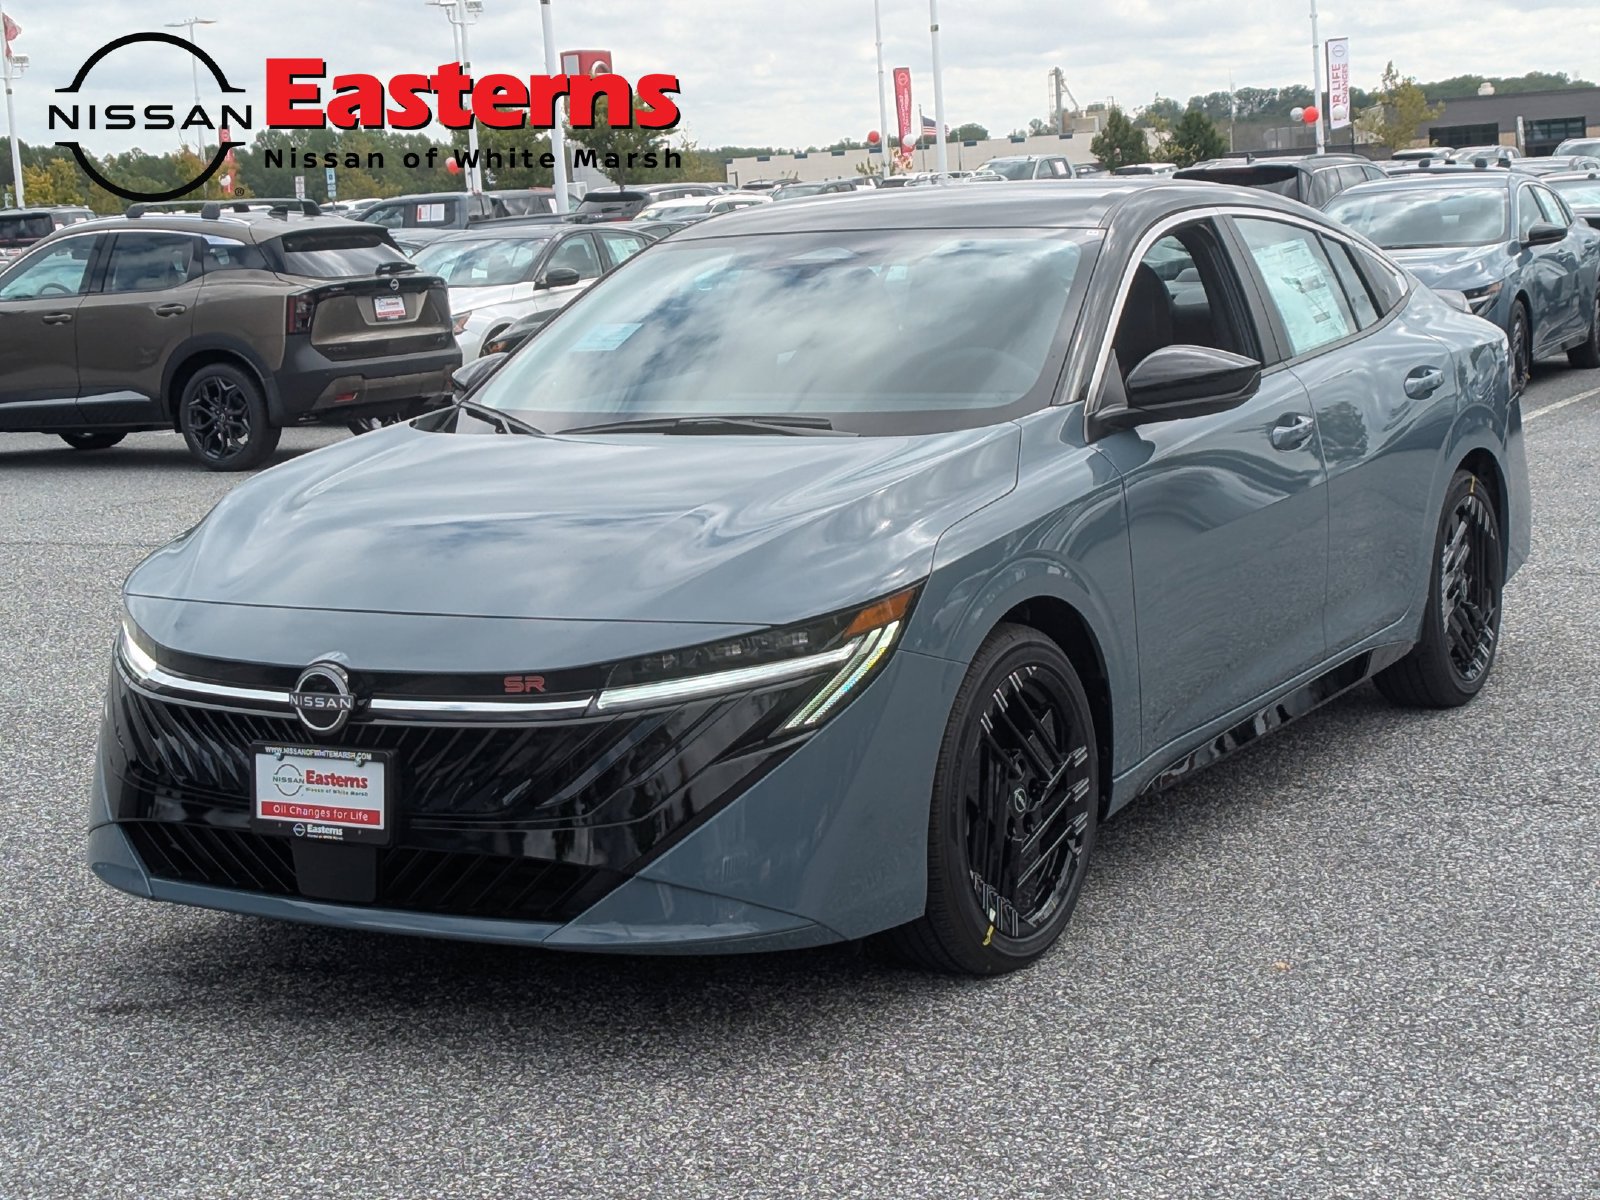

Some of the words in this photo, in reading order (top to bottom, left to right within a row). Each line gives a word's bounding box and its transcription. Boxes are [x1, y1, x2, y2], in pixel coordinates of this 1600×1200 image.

[1332, 64, 1341, 91] LIFE
[504, 676, 546, 692] SR
[290, 695, 351, 709] NISSAN
[272, 776, 304, 785] NISSAN
[305, 769, 368, 789] Easterns
[273, 804, 286, 813] Oil
[289, 806, 331, 818] Changes
[333, 809, 347, 819] for
[350, 811, 368, 821] Life
[307, 824, 343, 836] Easterns
